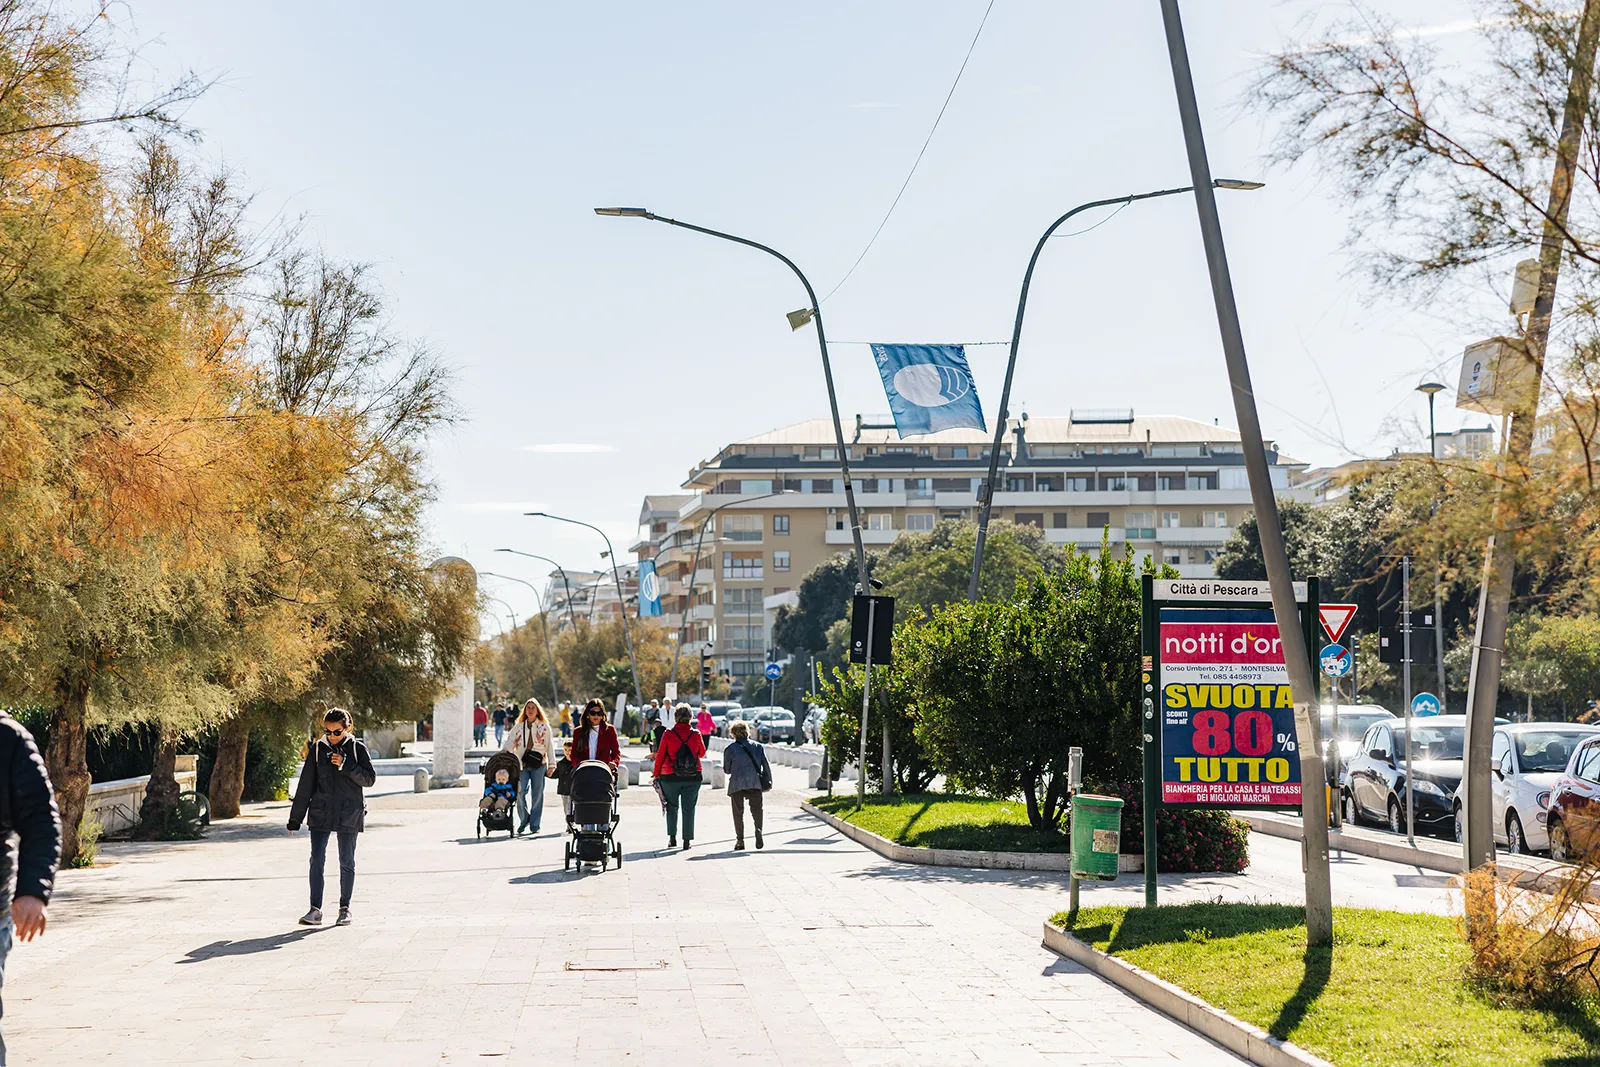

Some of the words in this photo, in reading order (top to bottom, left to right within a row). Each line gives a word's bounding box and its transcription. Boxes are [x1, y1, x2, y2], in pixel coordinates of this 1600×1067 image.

[1170, 583, 1197, 595] Città
[1200, 584, 1210, 595] di
[1213, 584, 1258, 596] Pescara
[1165, 632, 1224, 654] notti
[1230, 631, 1283, 655] d'or
[1240, 665, 1287, 673] MONTESILVA
[1165, 684, 1294, 708] SVUOTA
[1192, 709, 1274, 756] 80
[1276, 733, 1296, 752] %
[1174, 757, 1290, 783] TUTTO
[1165, 784, 1208, 793] BIANCHERIA
[1209, 785, 1223, 793] PER
[1224, 785, 1233, 793] LA
[1234, 785, 1253, 793] CASA
[1254, 785, 1260, 793] E
[1261, 785, 1301, 794] MATERASSI
[1196, 793, 1209, 802] DEI
[1210, 793, 1241, 802] MIGLIORI
[1242, 794, 1270, 803] MARCHI
